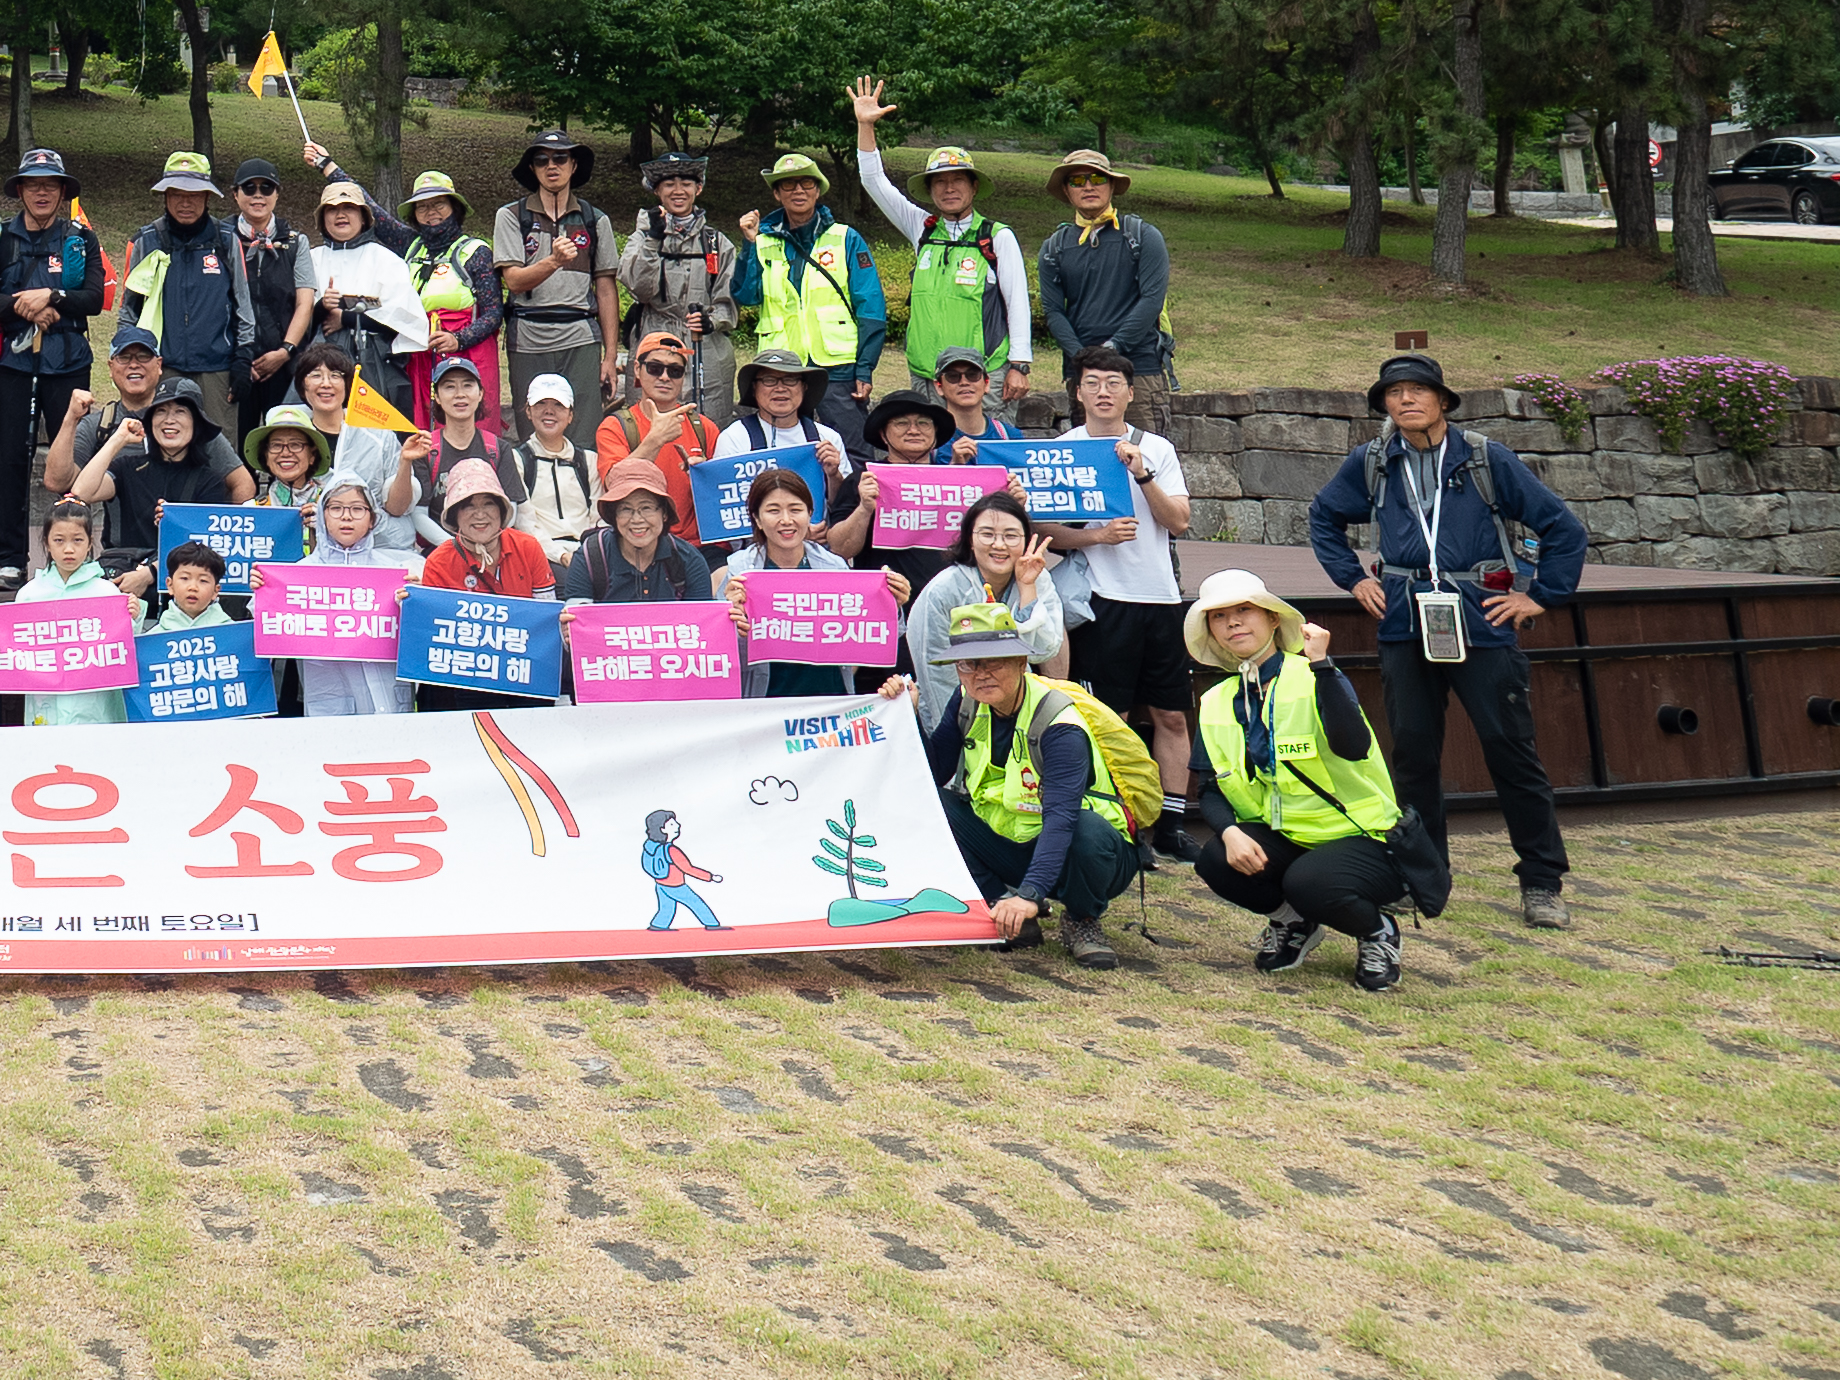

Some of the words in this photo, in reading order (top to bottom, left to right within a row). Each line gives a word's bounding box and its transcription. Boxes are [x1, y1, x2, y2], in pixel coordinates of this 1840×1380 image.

[1026, 449, 1074, 464] 2025
[1082, 490, 1106, 511] 해
[208, 514, 255, 532] 2025
[879, 507, 938, 531] 남해로
[286, 585, 380, 611] 국민고향,
[772, 593, 868, 617] 국민고향,
[456, 600, 509, 623] 2025
[13, 617, 106, 646] 국민고향,
[261, 611, 327, 637] 남해로
[334, 615, 398, 639] 오시다
[432, 618, 529, 654] 고향사랑
[604, 623, 707, 650] 국민고향,
[751, 617, 814, 643] 남해로
[821, 621, 890, 645] 오시다
[63, 641, 128, 671] 오시다
[166, 636, 216, 659] 2025
[149, 654, 239, 688] 고향사랑
[428, 646, 500, 680] 방문의
[506, 657, 531, 684] 해
[581, 655, 653, 681] 남해로
[660, 654, 732, 679] 오시다
[149, 685, 218, 717] 방문의
[223, 682, 247, 707] 해
[784, 715, 840, 736] VISIT
[1278, 743, 1310, 754] STAFF
[184, 758, 447, 882] 소풍
[55, 916, 82, 931] 세
[93, 916, 149, 931] 번째
[160, 914, 260, 932] 토요일]
